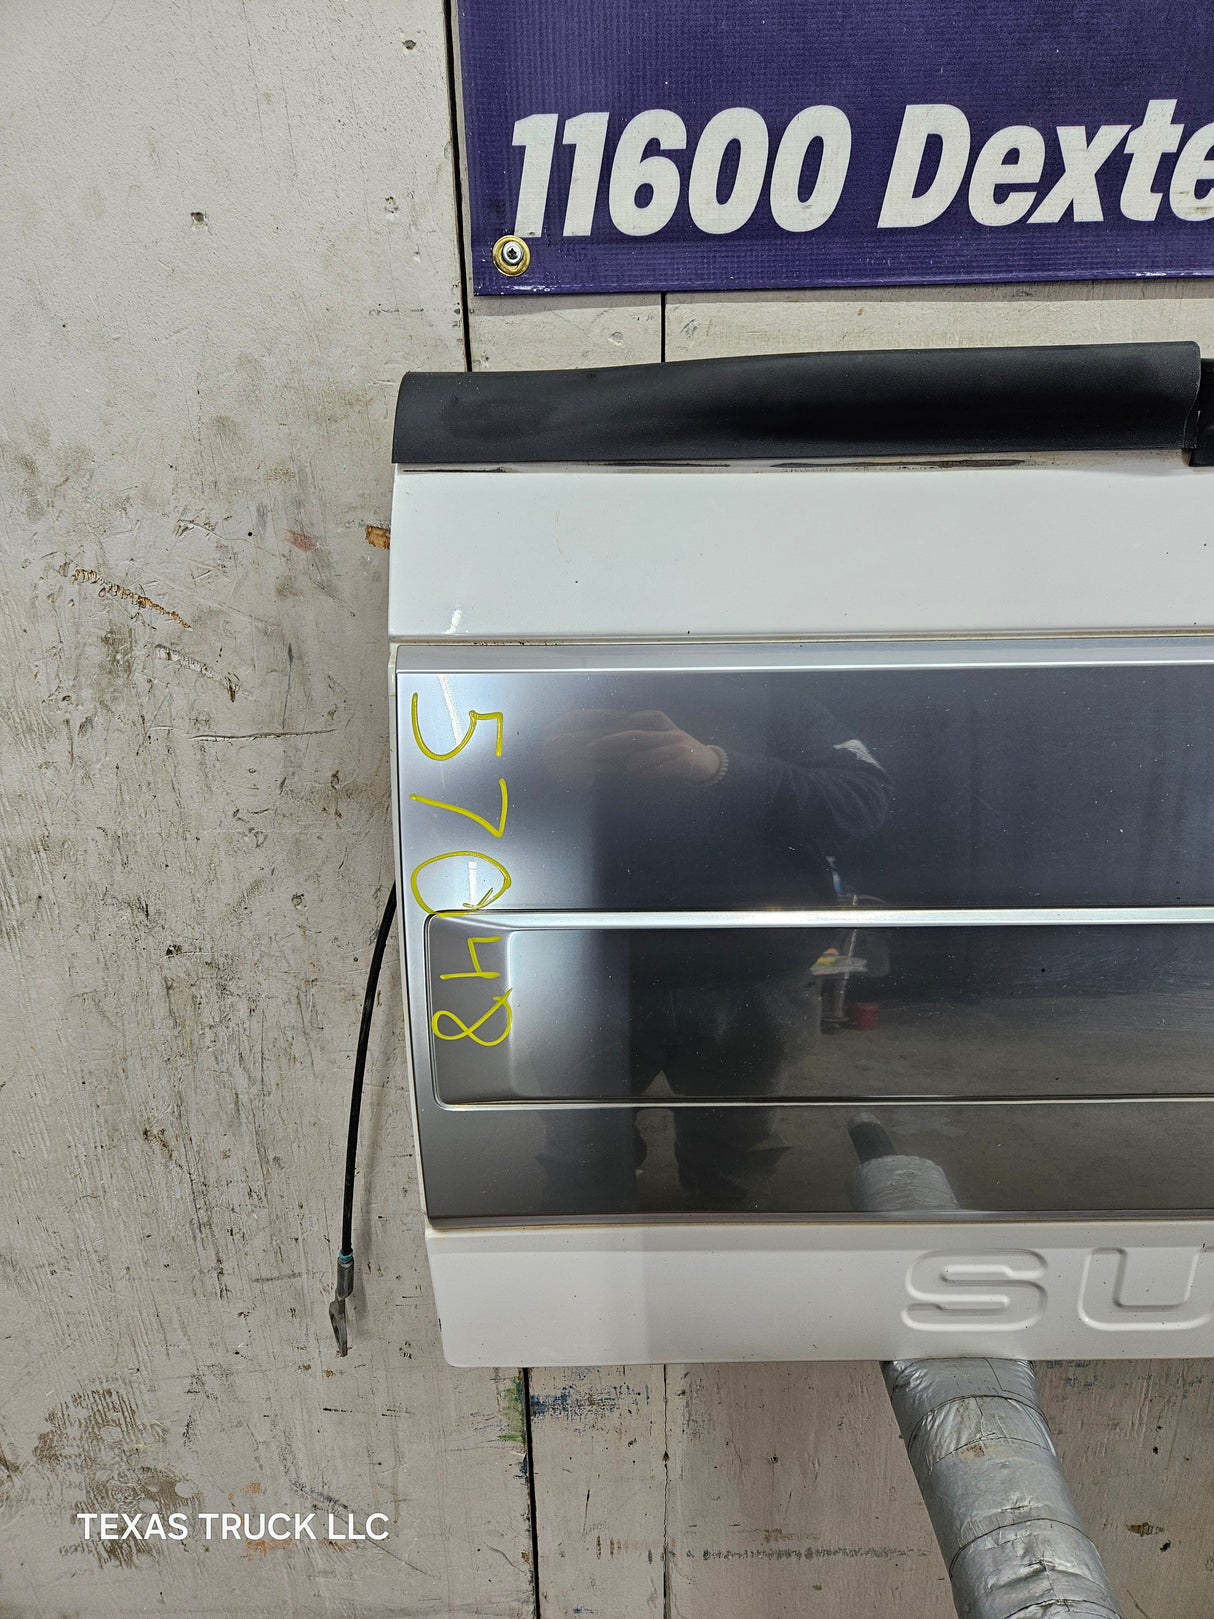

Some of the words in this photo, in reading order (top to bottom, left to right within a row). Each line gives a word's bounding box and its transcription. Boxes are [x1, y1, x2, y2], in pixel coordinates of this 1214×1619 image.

[511, 103, 852, 238] 11600
[877, 98, 1214, 229] Dexte
[409, 691, 513, 1047] 57048
[901, 1248, 1214, 1333] SU
